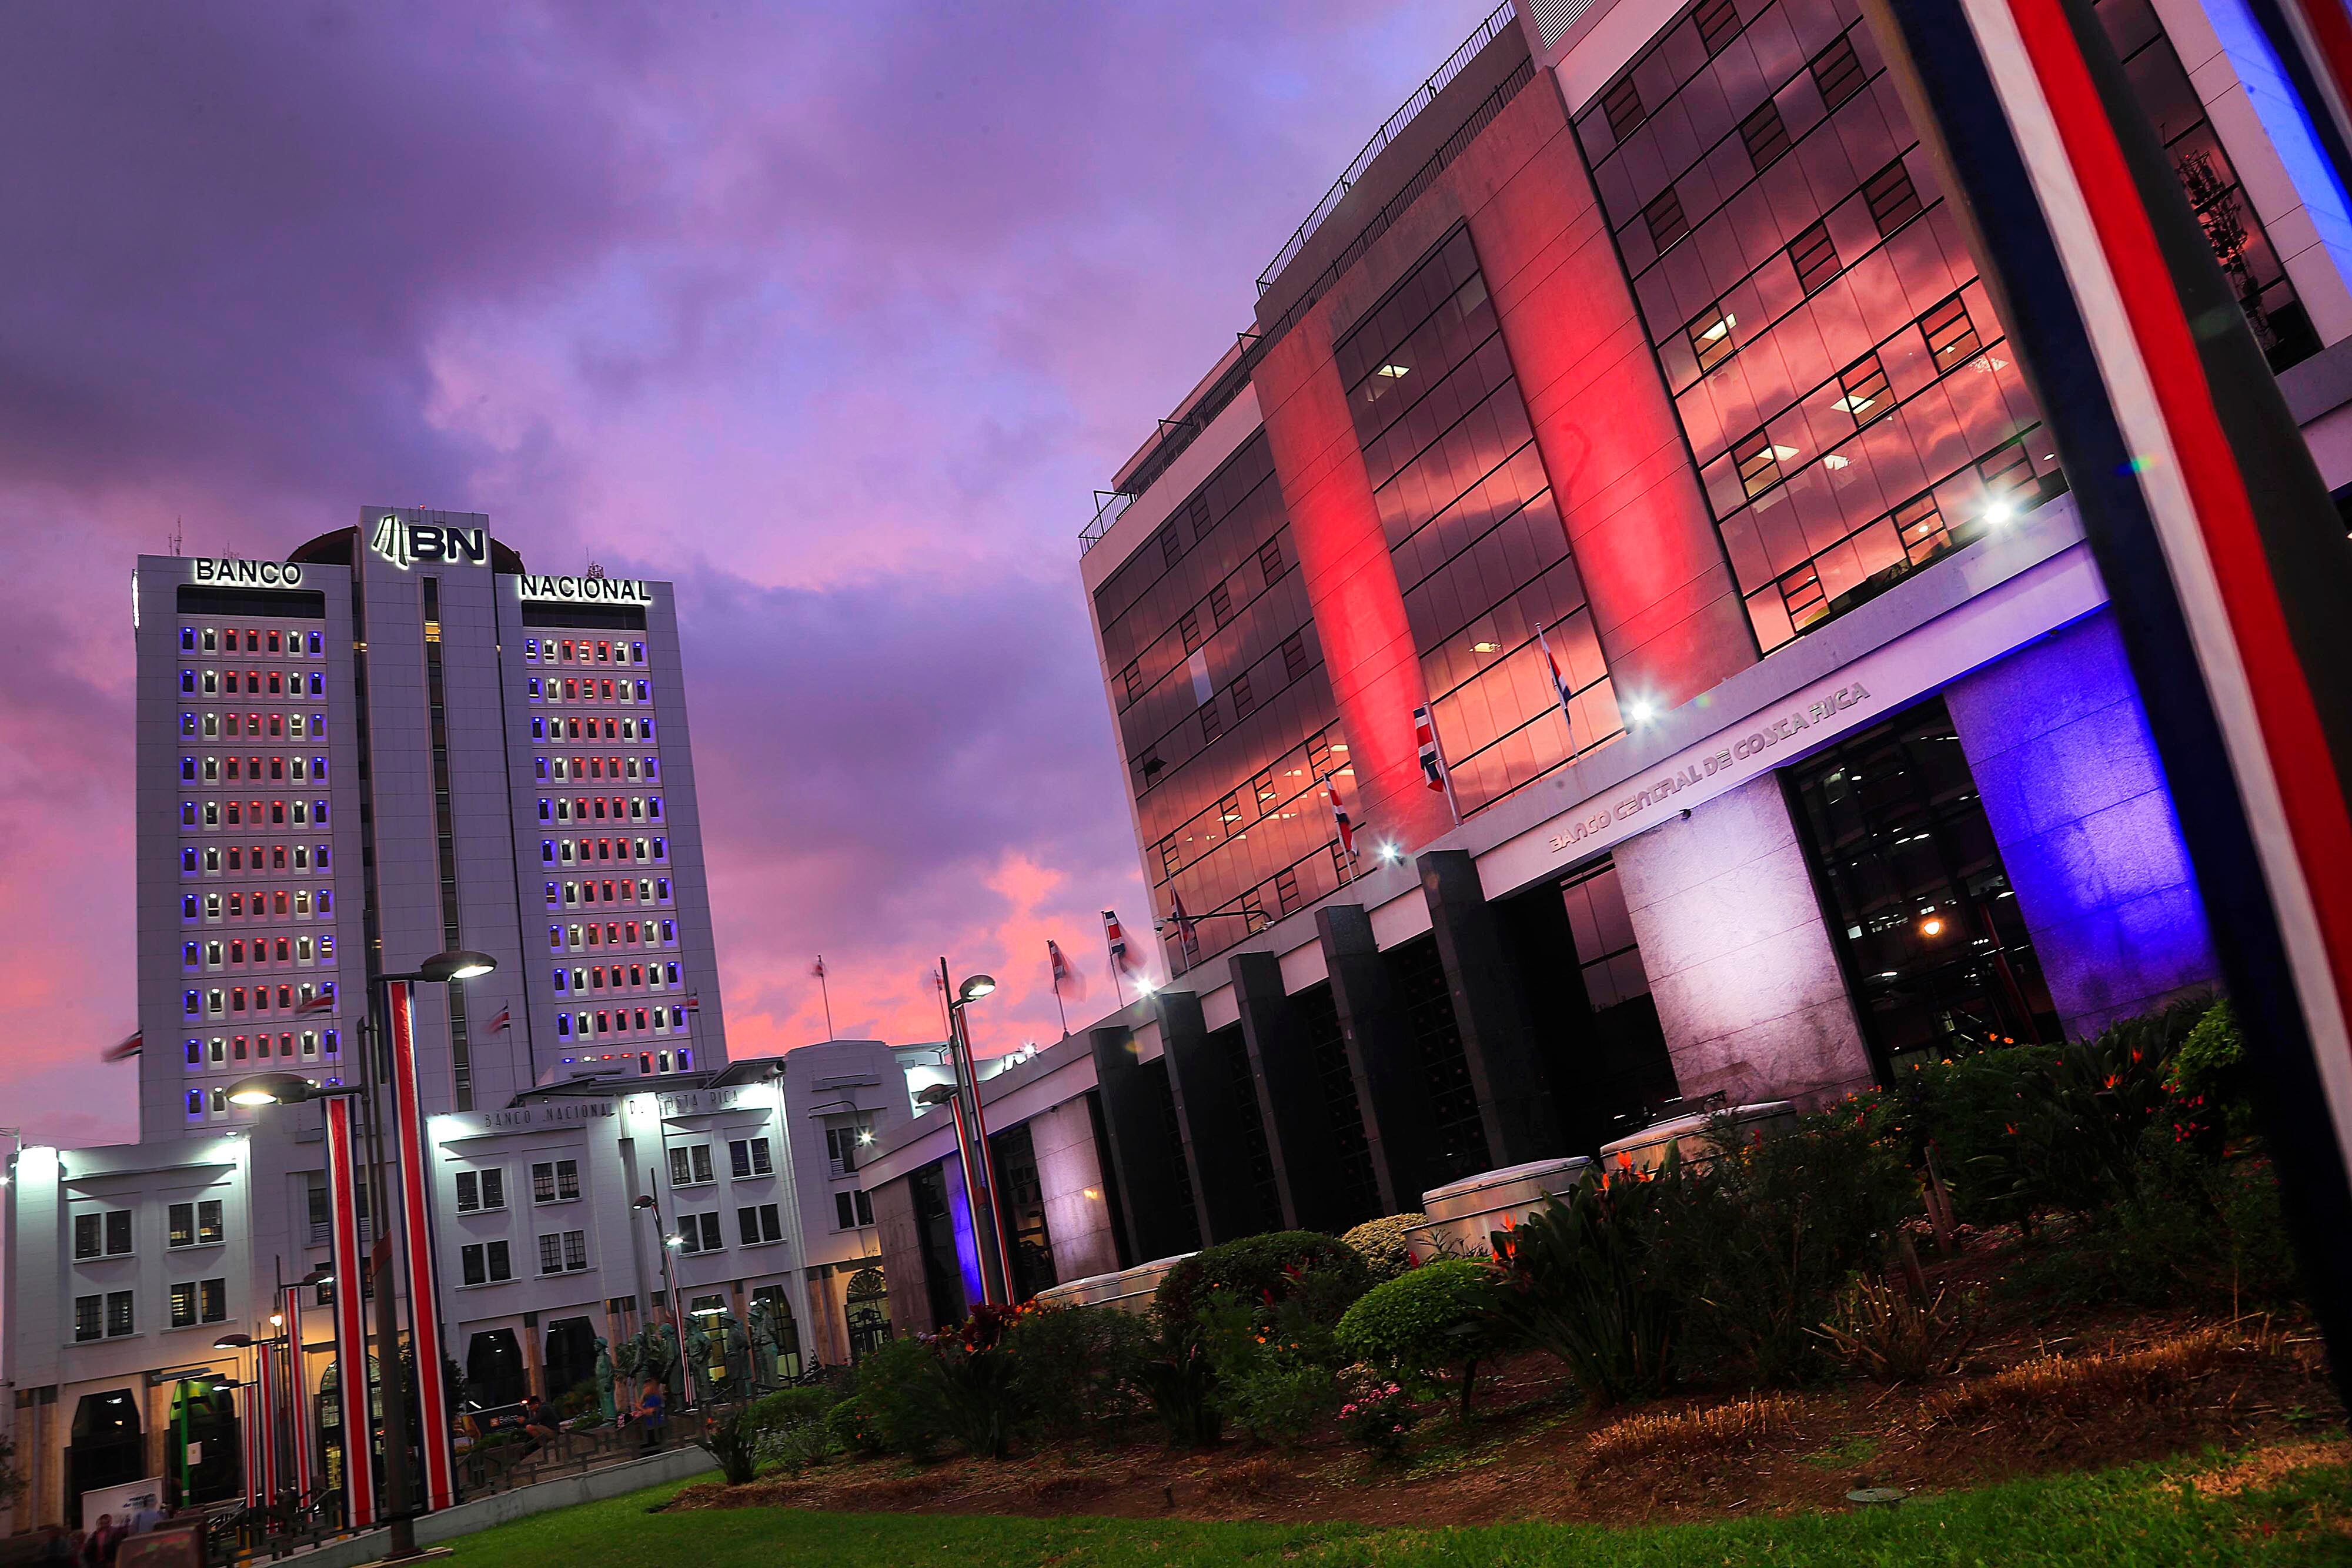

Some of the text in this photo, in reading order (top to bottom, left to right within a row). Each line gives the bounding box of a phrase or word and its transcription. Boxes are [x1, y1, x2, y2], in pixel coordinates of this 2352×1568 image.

[409, 525, 485, 560] BN
[197, 557, 652, 601] BANCO NACIONAL
[1549, 682, 1871, 853] BANCO CENTRAL DE COSTA RICA
[485, 1110, 531, 1127] BANCO
[546, 1103, 612, 1120] NACIONA
[710, 1090, 739, 1104] RICA
